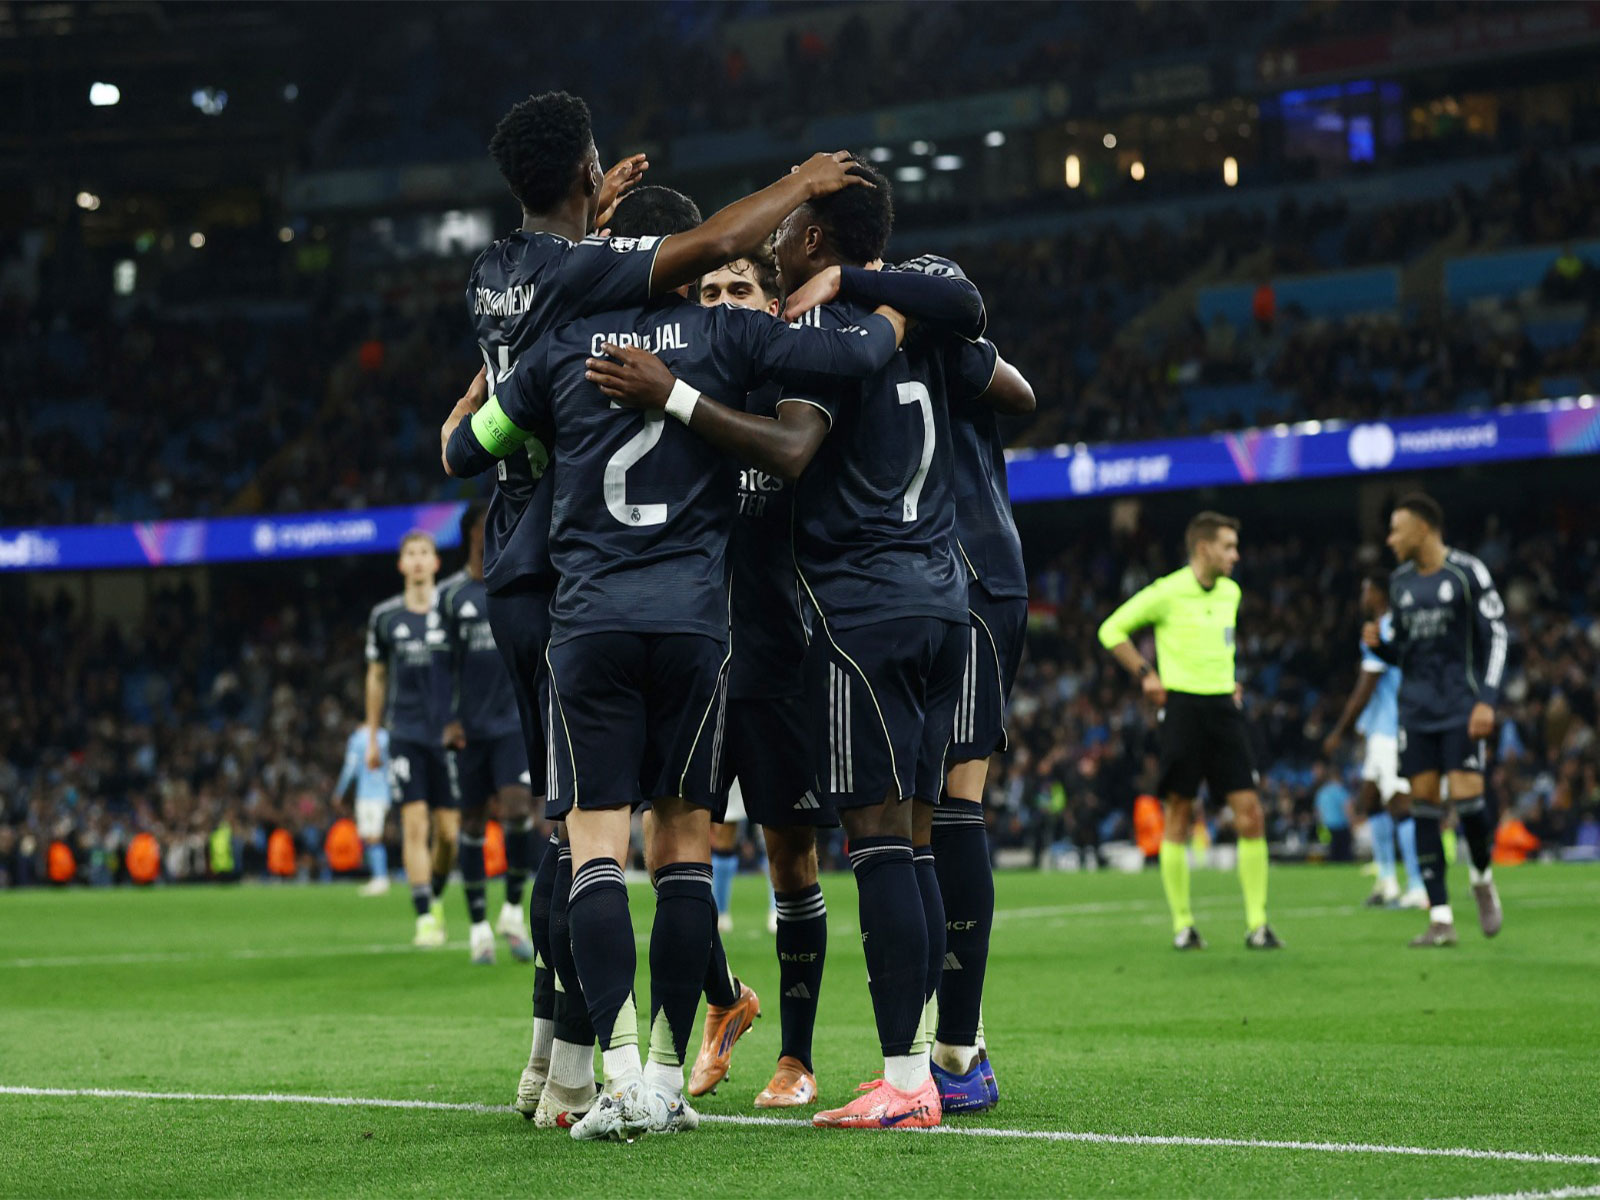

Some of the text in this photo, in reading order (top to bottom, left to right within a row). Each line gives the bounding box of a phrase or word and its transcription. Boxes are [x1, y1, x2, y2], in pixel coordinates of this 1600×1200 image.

[603, 400, 668, 527] 2
[896, 380, 936, 522] 7
[738, 492, 767, 517] TER
[780, 952, 818, 962] RMCF
